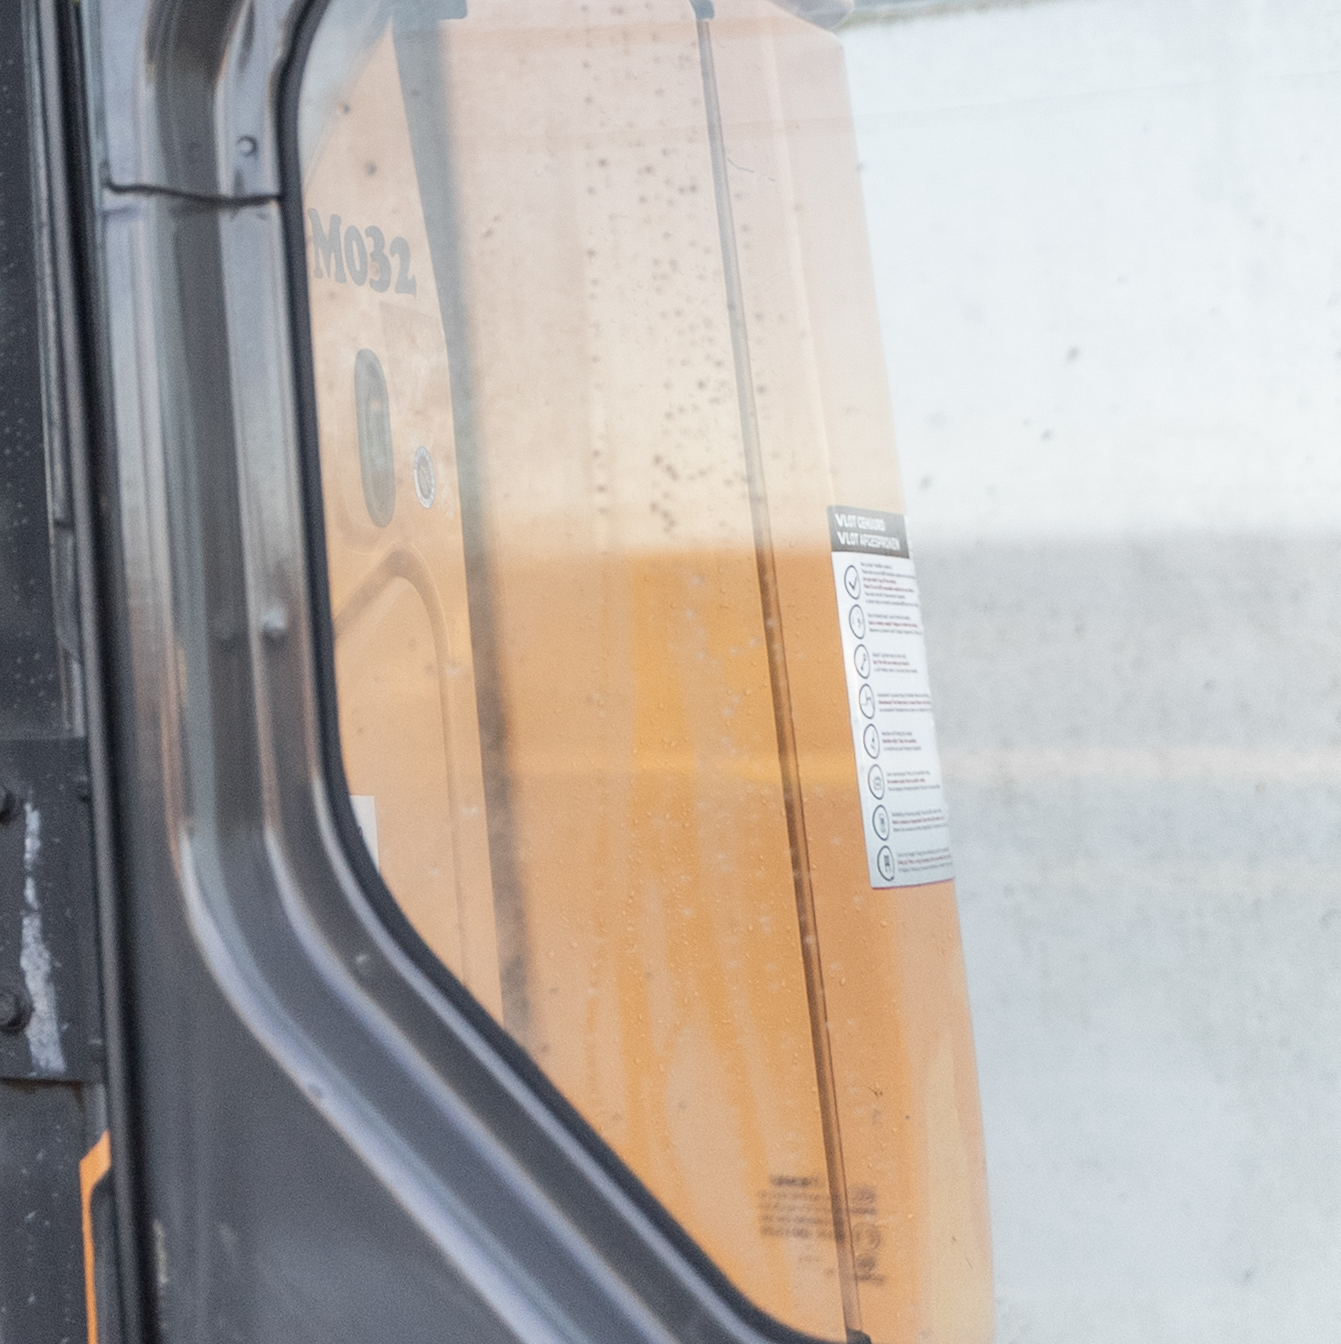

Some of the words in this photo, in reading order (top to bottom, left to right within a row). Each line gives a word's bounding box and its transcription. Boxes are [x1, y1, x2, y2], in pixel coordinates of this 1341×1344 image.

[307, 207, 417, 297] M032
[834, 513, 857, 529] VLOT
[836, 531, 859, 547] VLOT
